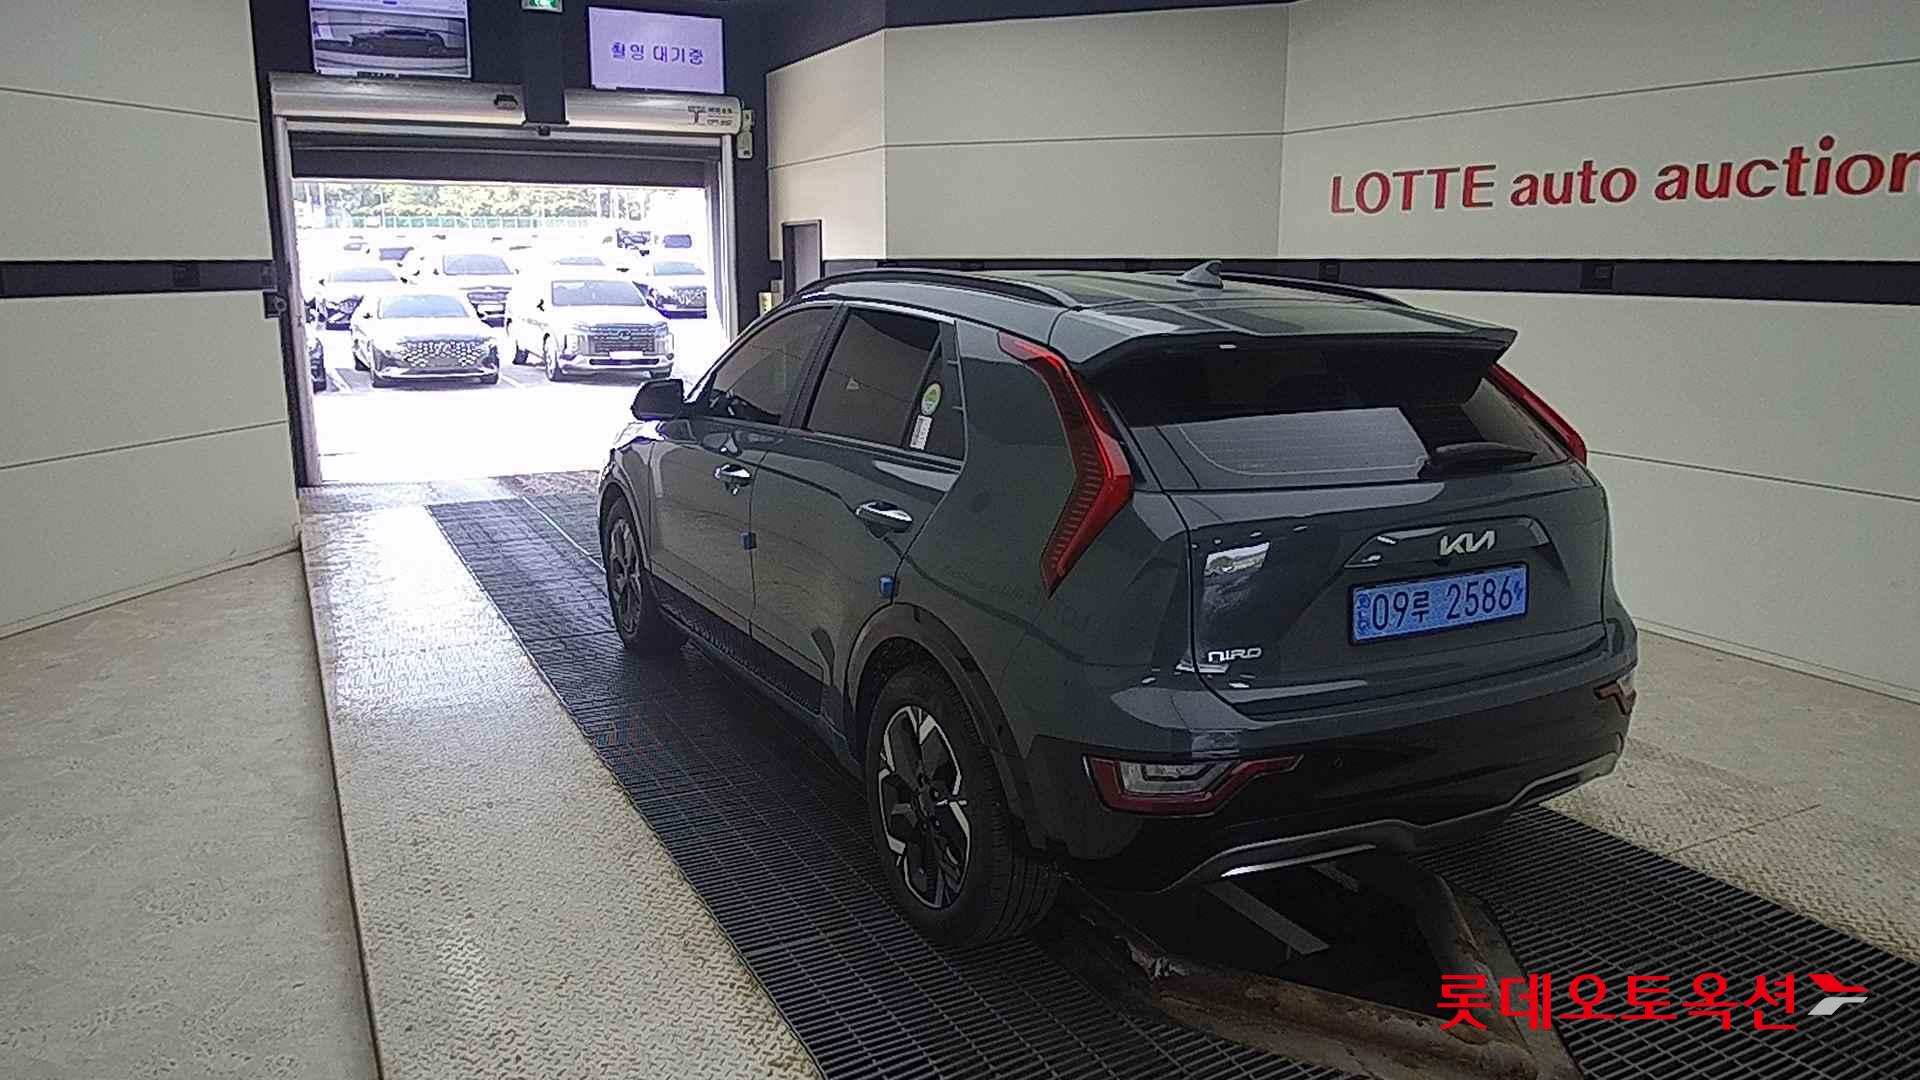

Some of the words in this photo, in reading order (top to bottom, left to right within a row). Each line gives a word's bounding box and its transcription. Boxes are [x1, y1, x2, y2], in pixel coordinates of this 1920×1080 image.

[612, 42, 645, 61] 촬영
[652, 45, 704, 66] 대기중
[1330, 164, 1497, 215] LOTTE
[1510, 160, 1638, 207] auto
[1372, 590, 1430, 631] 09루
[1446, 575, 1513, 621] 2586
